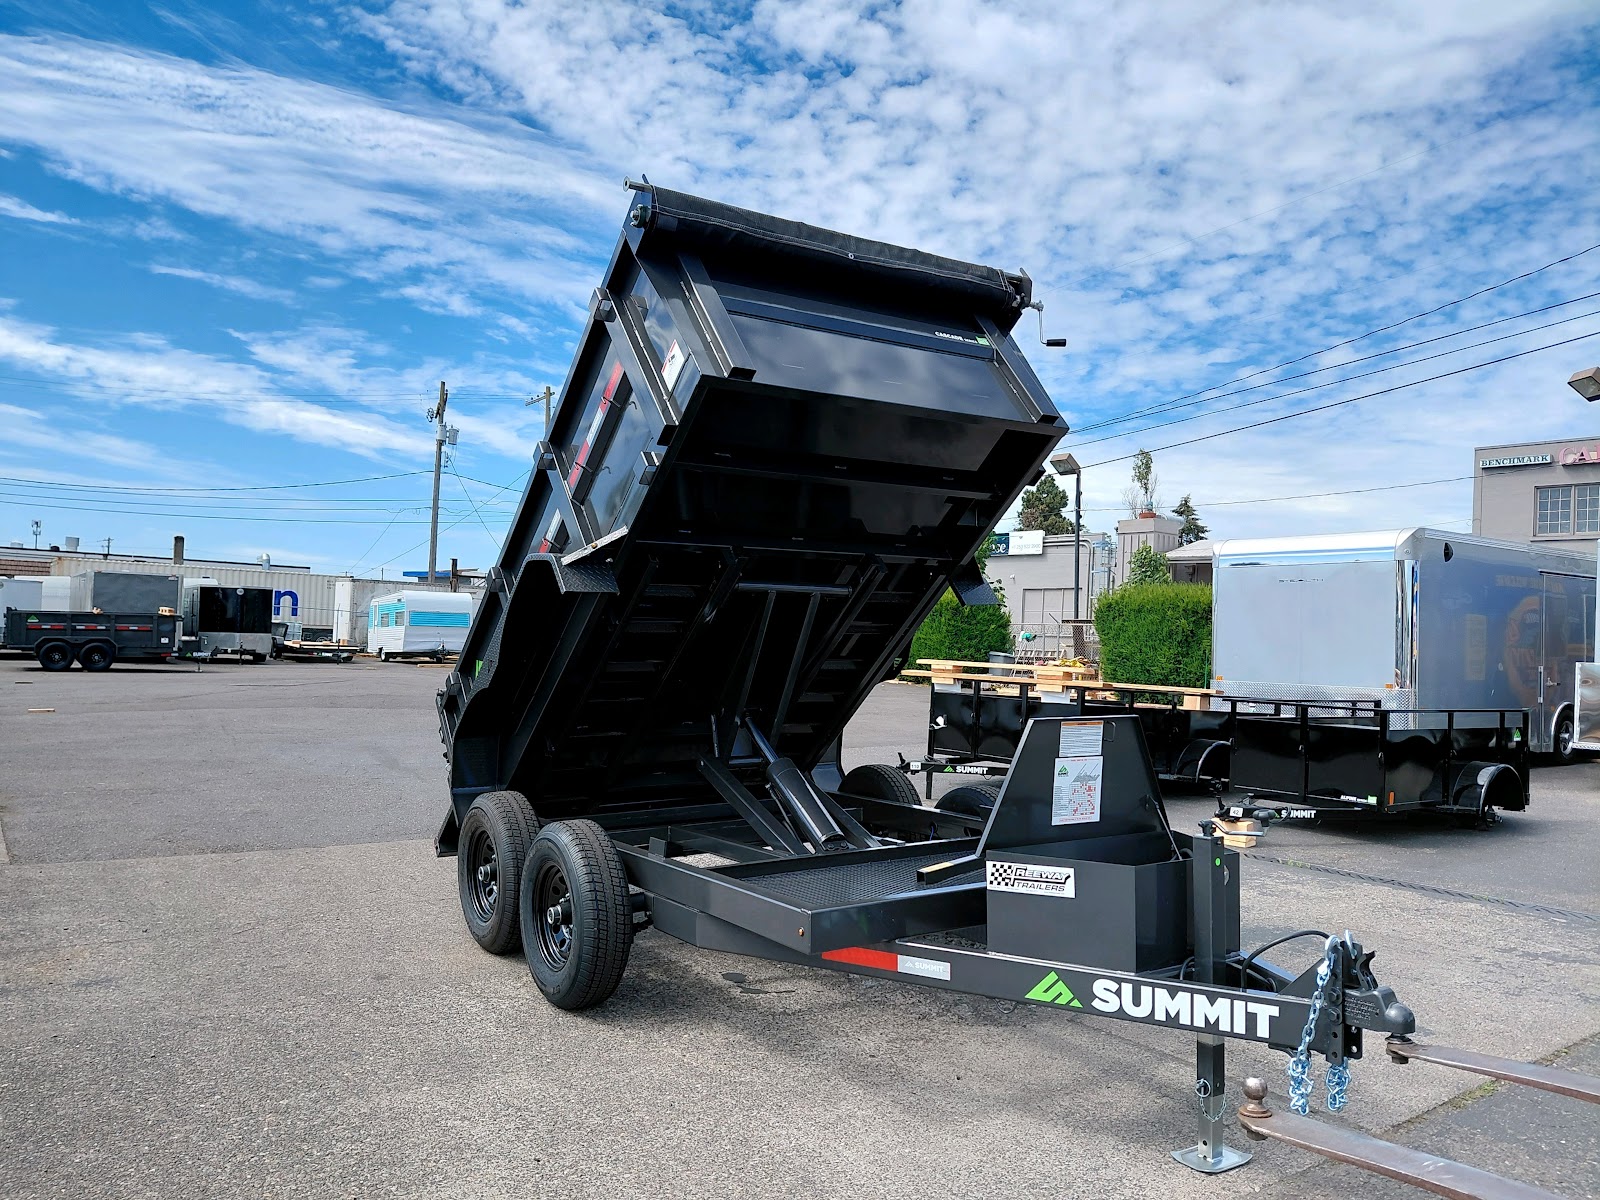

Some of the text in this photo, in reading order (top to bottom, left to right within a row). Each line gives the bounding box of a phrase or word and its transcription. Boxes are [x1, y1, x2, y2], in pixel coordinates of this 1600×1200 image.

[1480, 454, 1549, 467] BENCHMARK
[955, 765, 988, 774] SUMMIT
[1016, 881, 1066, 892] TRAILERS
[914, 962, 944, 973] SUMMIT
[1091, 978, 1280, 1039] SUMMIT
